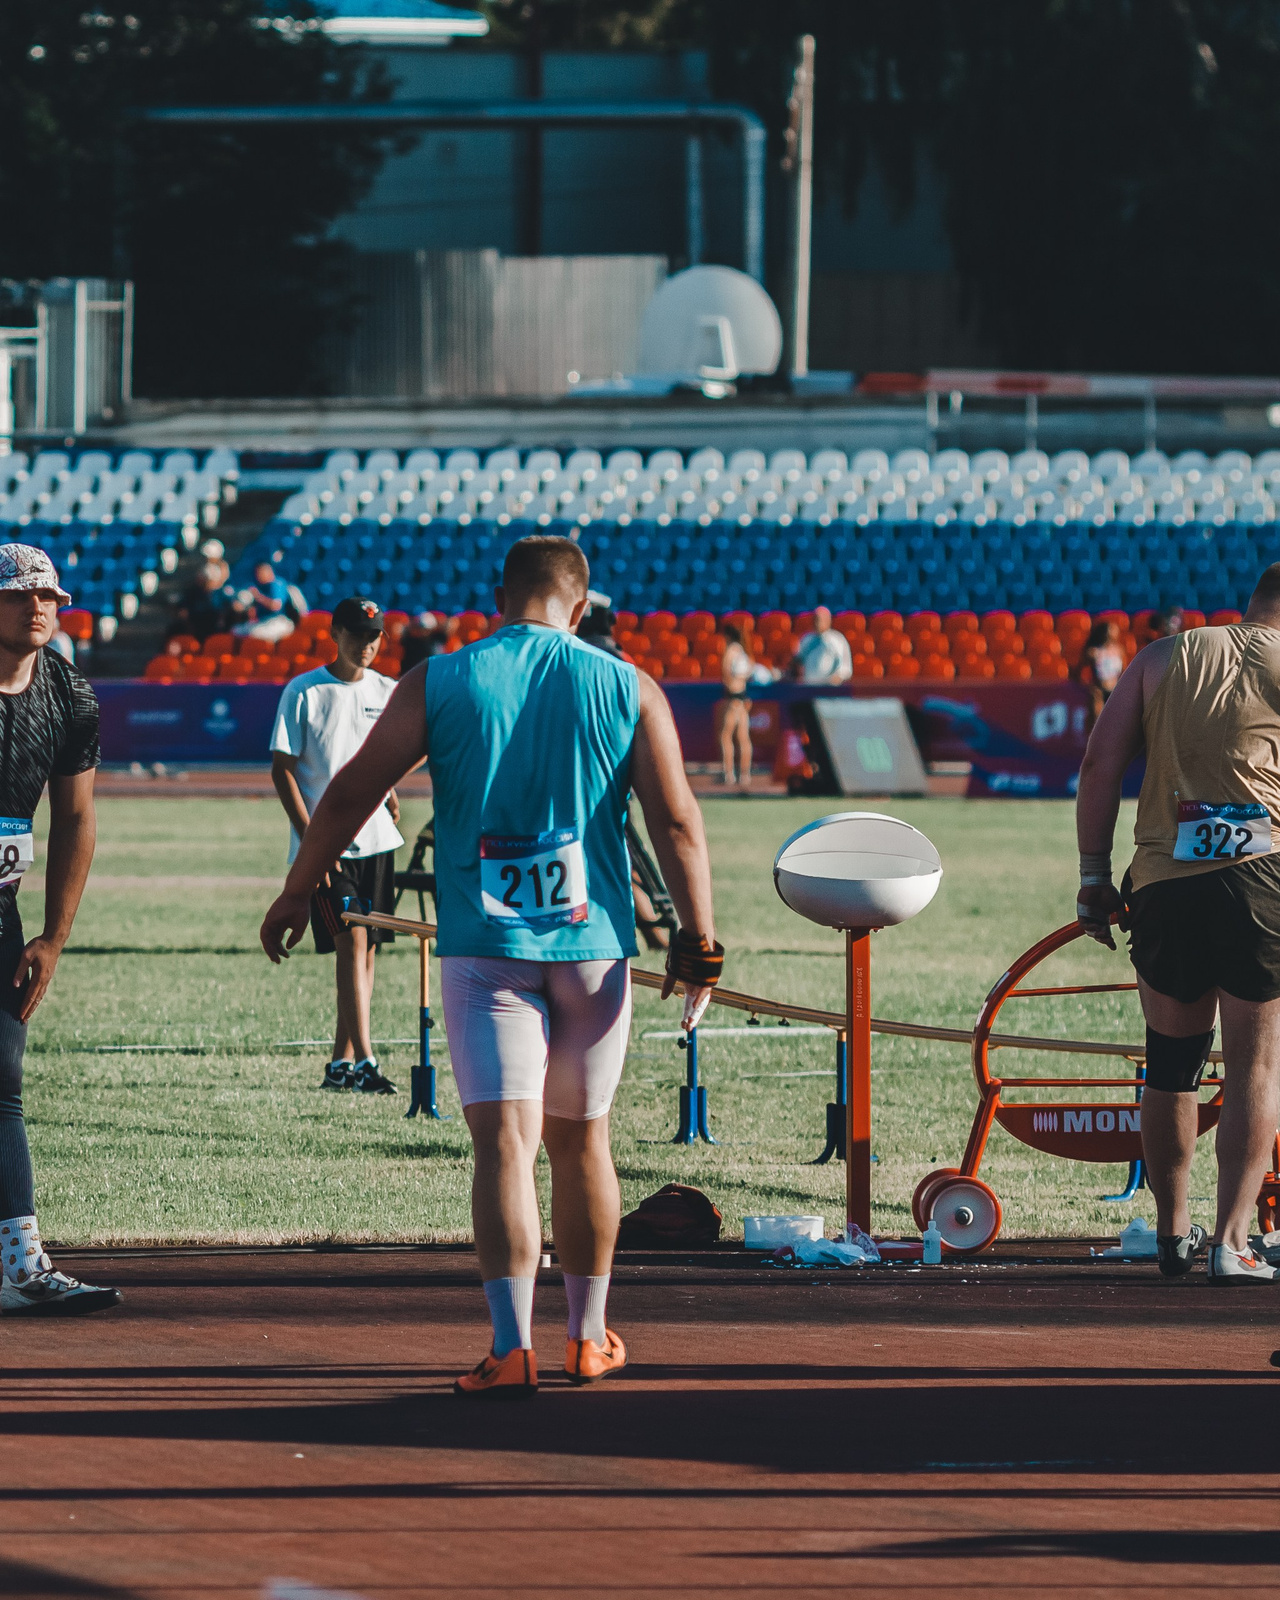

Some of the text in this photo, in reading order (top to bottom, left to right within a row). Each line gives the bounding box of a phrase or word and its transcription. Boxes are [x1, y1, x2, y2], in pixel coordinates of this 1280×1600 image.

[1193, 823, 1254, 858] 322
[500, 860, 571, 908] 212
[1063, 1110, 1141, 1133] MON
